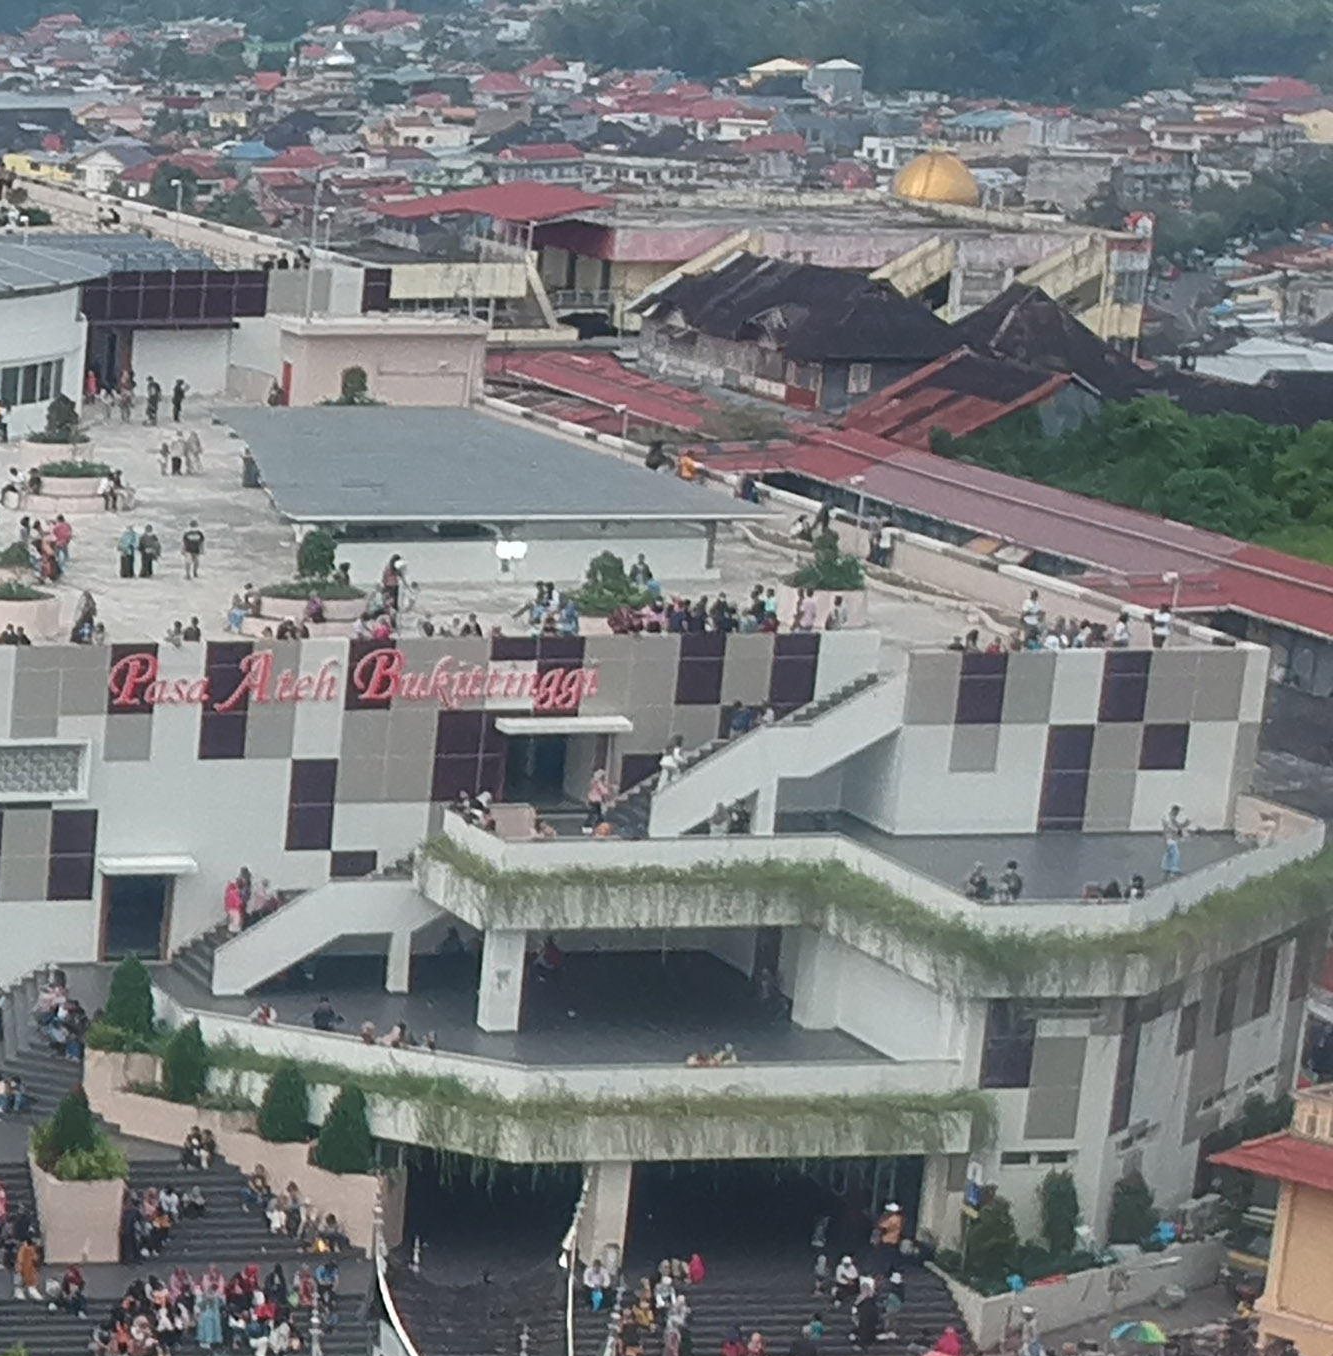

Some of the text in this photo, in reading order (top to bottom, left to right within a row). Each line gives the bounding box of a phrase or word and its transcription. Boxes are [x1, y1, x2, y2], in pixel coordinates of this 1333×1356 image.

[109, 647, 602, 714] Pasa Ateh Bukittinggi
